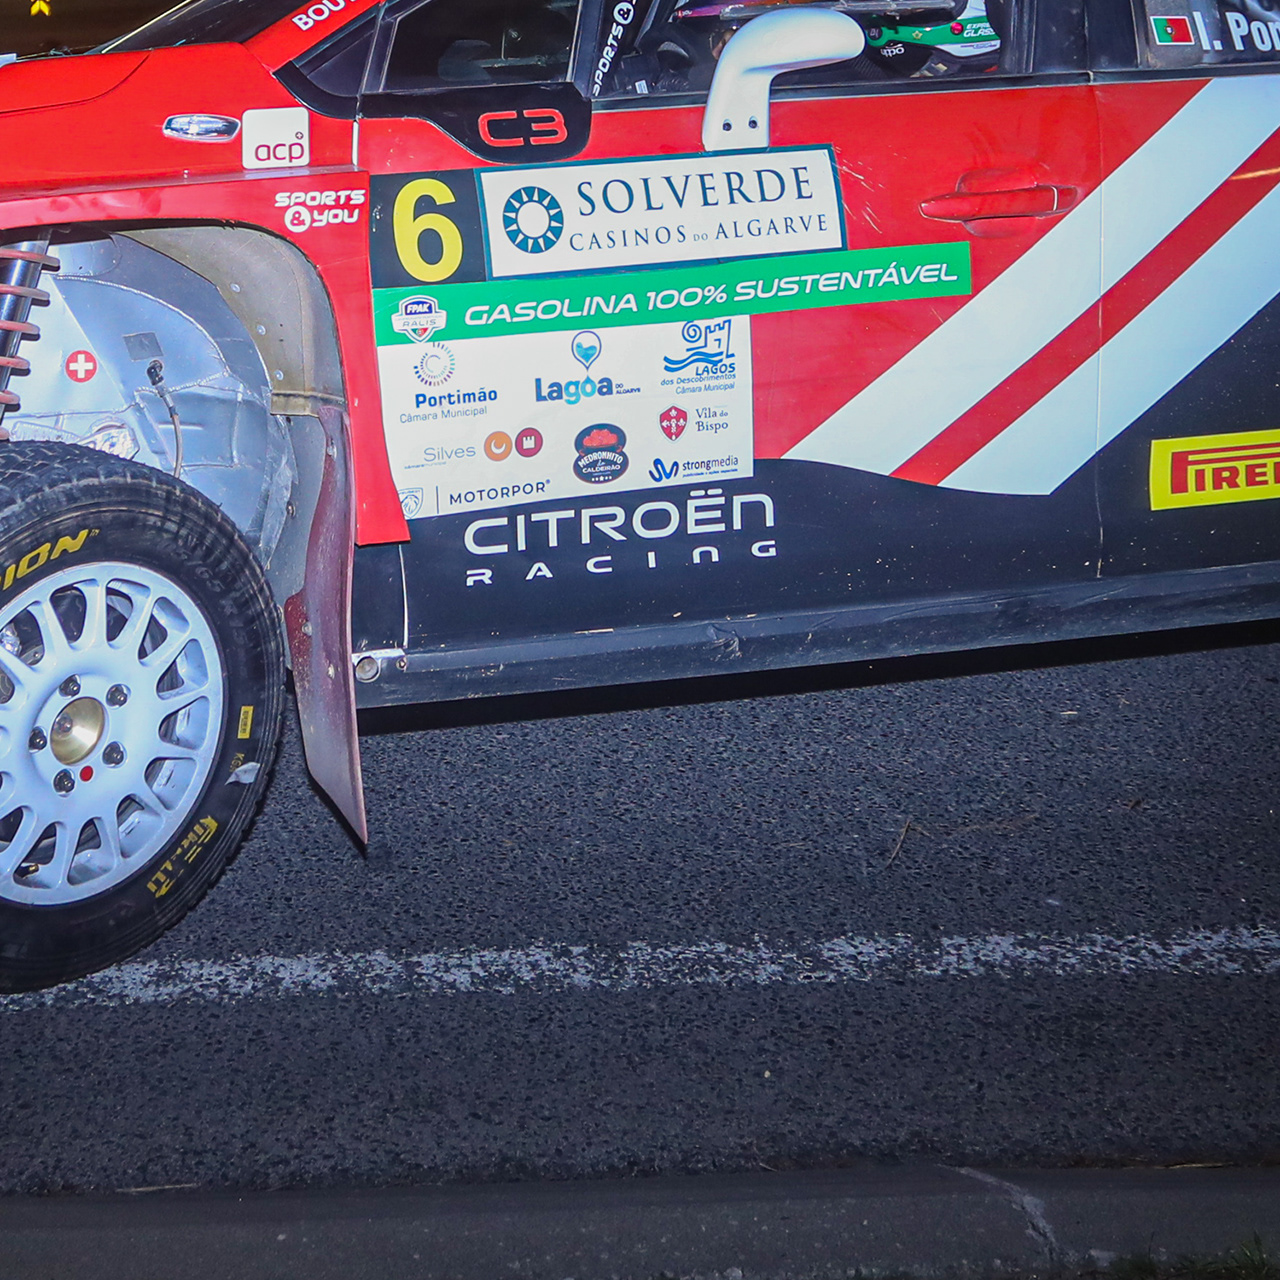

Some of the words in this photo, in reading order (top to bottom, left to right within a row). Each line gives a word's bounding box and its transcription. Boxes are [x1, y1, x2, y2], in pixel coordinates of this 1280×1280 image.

[478, 107, 568, 148] C3
[255, 141, 305, 163] acp
[274, 189, 366, 207] SPORTS
[578, 166, 814, 217] SOLVERDE
[392, 178, 464, 283] 6
[569, 224, 688, 252] CASINOS
[715, 213, 829, 241] ALGARVE
[464, 293, 638, 326] GASOLINA
[646, 284, 727, 313] 100%
[734, 262, 959, 301] SUSTENTÁVEL
[406, 303, 431, 314] FPAK
[403, 318, 437, 327] RALIS
[695, 363, 736, 376] LAGOS
[676, 373, 737, 385] Descobrimentos
[703, 381, 736, 392] Municipal
[415, 387, 498, 409] Portimão
[535, 374, 614, 405] Lagoa
[400, 411, 438, 424] Câmara
[441, 406, 488, 419] Municipal
[695, 407, 718, 419] Vila
[695, 420, 729, 434] Bispo
[423, 446, 476, 462] Silves
[577, 451, 624, 468] MEDRONHITO
[682, 455, 739, 471] strongmedia
